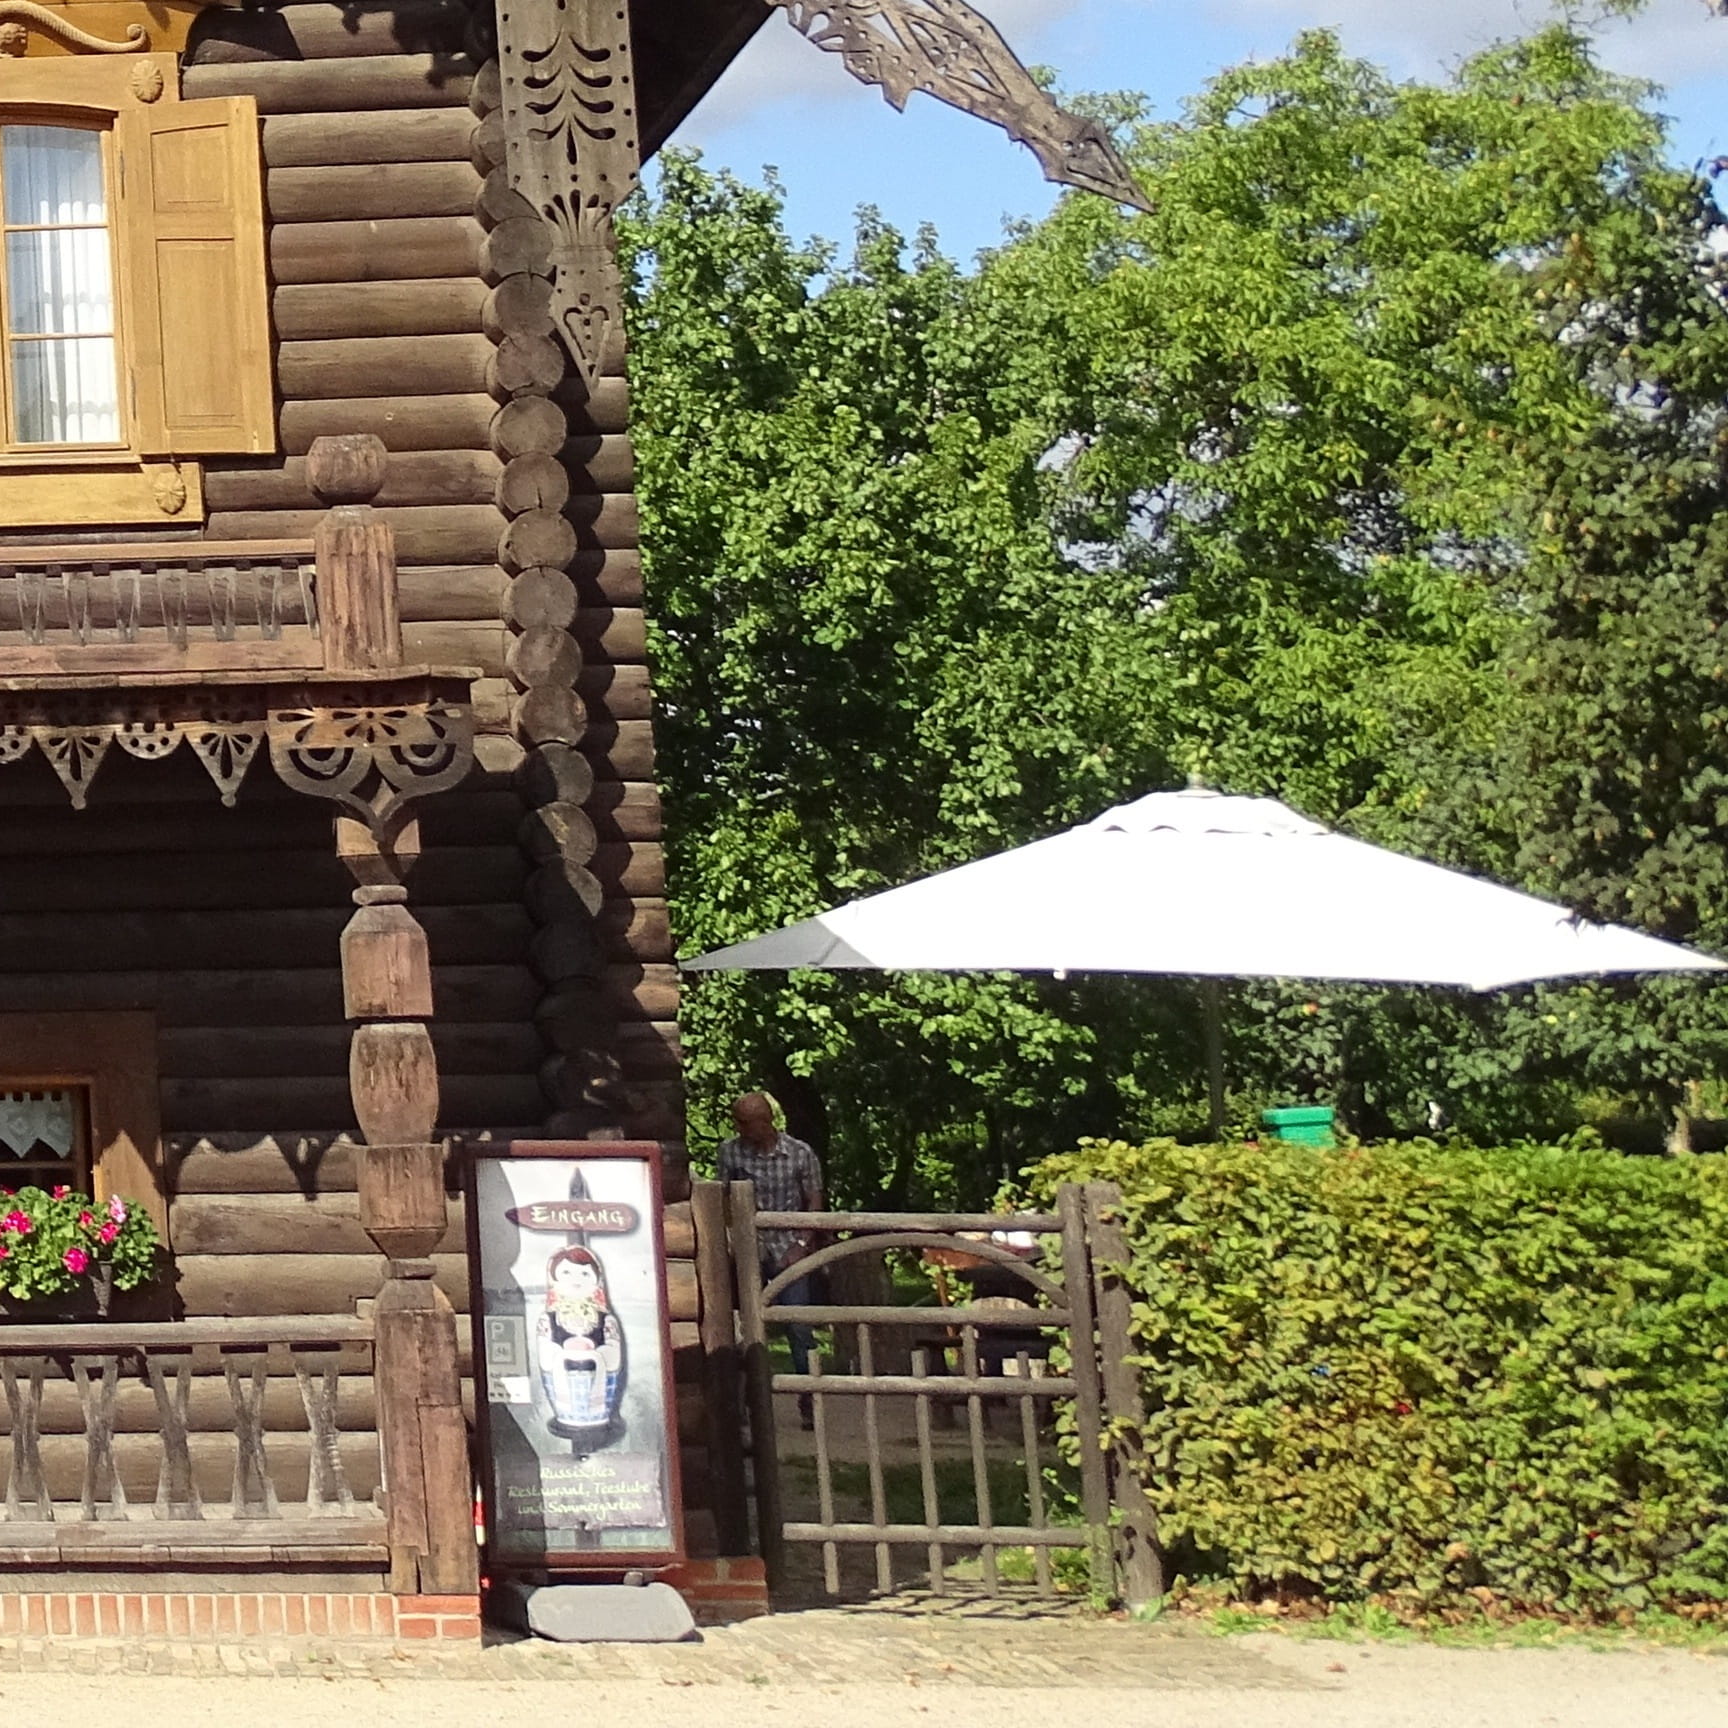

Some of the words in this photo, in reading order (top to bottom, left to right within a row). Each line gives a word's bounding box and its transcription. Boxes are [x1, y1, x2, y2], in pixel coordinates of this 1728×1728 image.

[530, 1206, 625, 1226] EINGANG
[540, 1465, 617, 1480] Russisches
[593, 1480, 651, 1495] Teestube
[547, 1499, 643, 1521] Sommergarten
